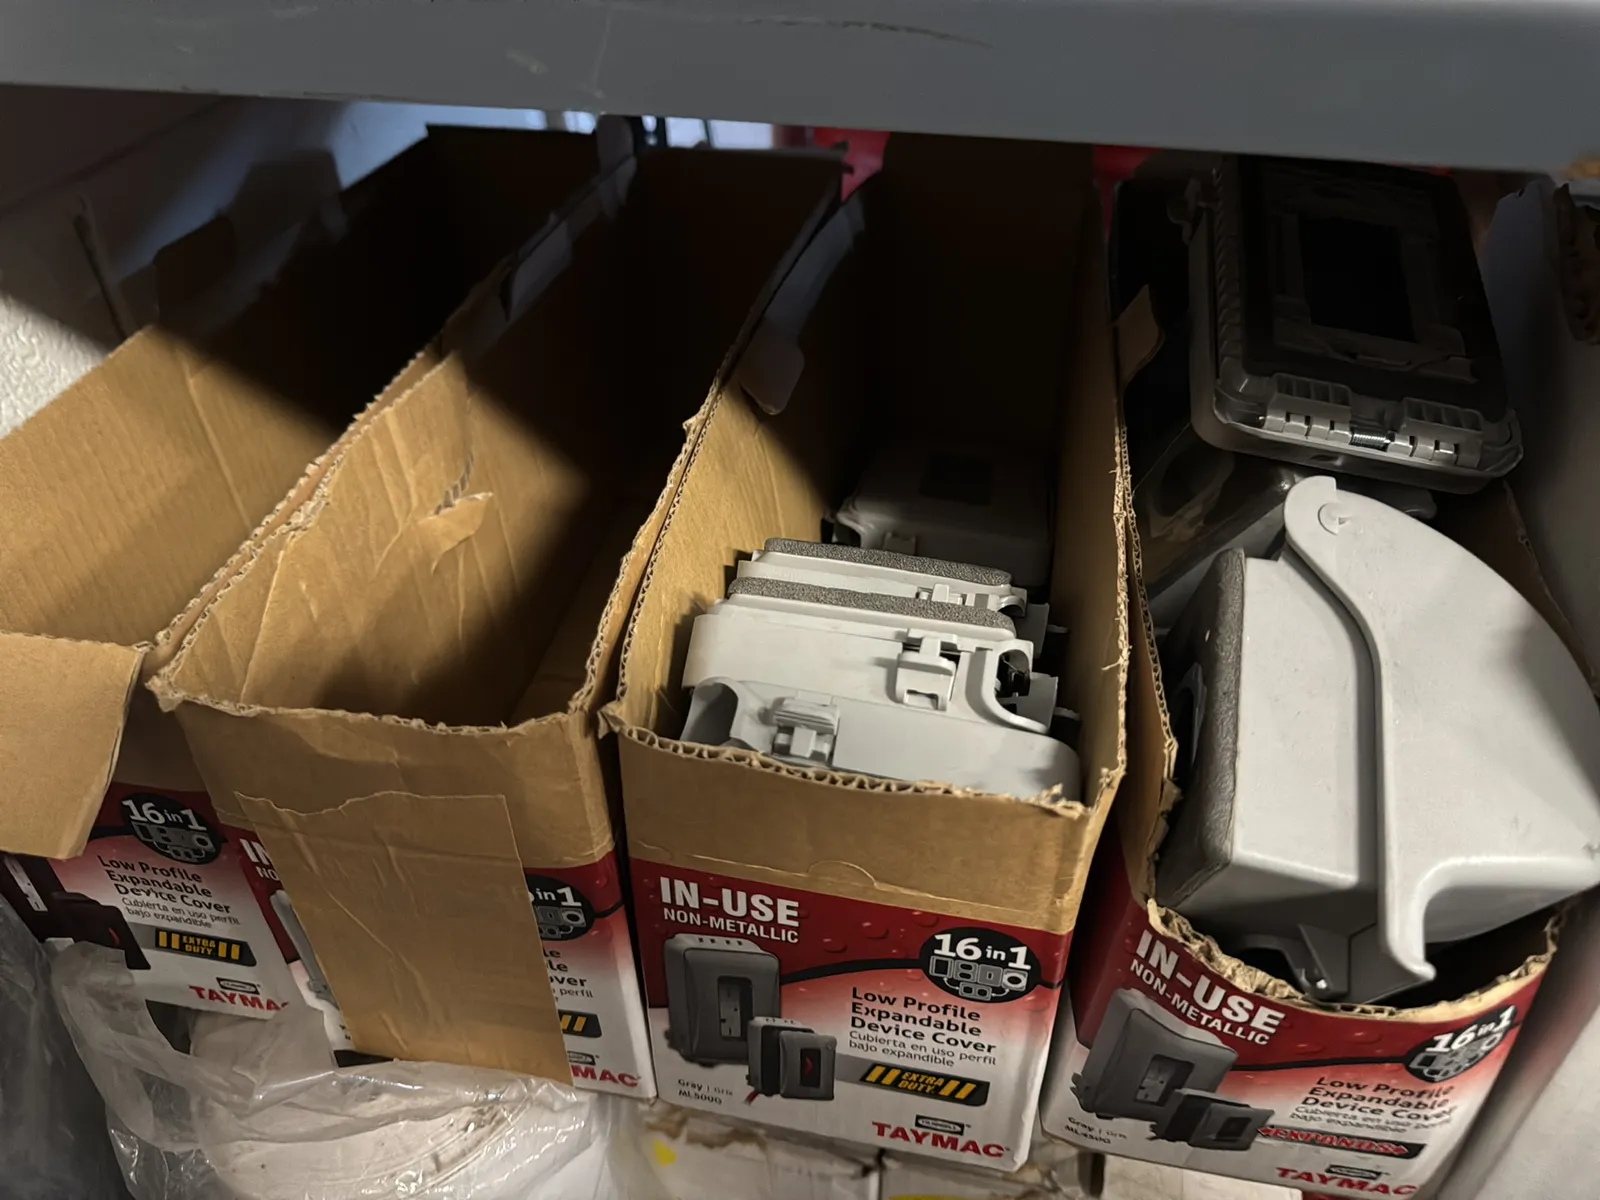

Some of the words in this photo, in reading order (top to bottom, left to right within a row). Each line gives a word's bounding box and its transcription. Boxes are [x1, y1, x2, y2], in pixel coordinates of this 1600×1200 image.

[122, 799, 164, 824] 16
[165, 810, 183, 824] in
[183, 809, 207, 831] 1
[97, 854, 136, 871] Low
[139, 861, 203, 883] Profile
[105, 869, 213, 898] Expandable
[557, 886, 582, 907] 1
[114, 883, 177, 903] Device
[180, 895, 231, 914] Cover
[121, 897, 169, 912] Cubierta
[188, 909, 207, 919] uso
[210, 914, 241, 926] perfil
[660, 876, 800, 927] IN-USE
[126, 907, 151, 918] bajo
[154, 912, 212, 928] expandible
[664, 908, 799, 943] NON-METALLIC
[183, 935, 216, 948] EXTRA
[934, 933, 982, 960] 16
[985, 946, 1006, 961] in
[1008, 945, 1031, 970] 1
[560, 988, 594, 998] perfil
[1135, 929, 1286, 1034] IN-USE
[852, 987, 897, 1006] Low
[903, 996, 981, 1021] Profile
[1130, 959, 1271, 1046] NON-METALLIC
[851, 1002, 982, 1036] Expandable
[1425, 1024, 1478, 1052] 16
[1477, 1022, 1497, 1036] in
[1493, 1005, 1516, 1032] 1
[849, 1030, 906, 1049] Cubierta
[910, 1044, 927, 1054] en
[932, 1047, 955, 1057] uso
[959, 1052, 997, 1066] perfil
[851, 1016, 925, 1040] Device
[932, 1032, 996, 1053] Cover
[849, 1040, 878, 1053] bajo
[882, 1048, 955, 1067] expandible
[678, 1079, 703, 1091] Gray
[902, 1072, 945, 1087] EXTRA
[1316, 1076, 1368, 1091] Low
[1373, 1083, 1455, 1099] Profile
[1301, 1096, 1384, 1115] Device
[1392, 1105, 1458, 1121] Cover
[1308, 1087, 1450, 1110] Expandable
[871, 1121, 1005, 1158] TAYMAC
[1276, 1167, 1418, 1195] TAYMAC
